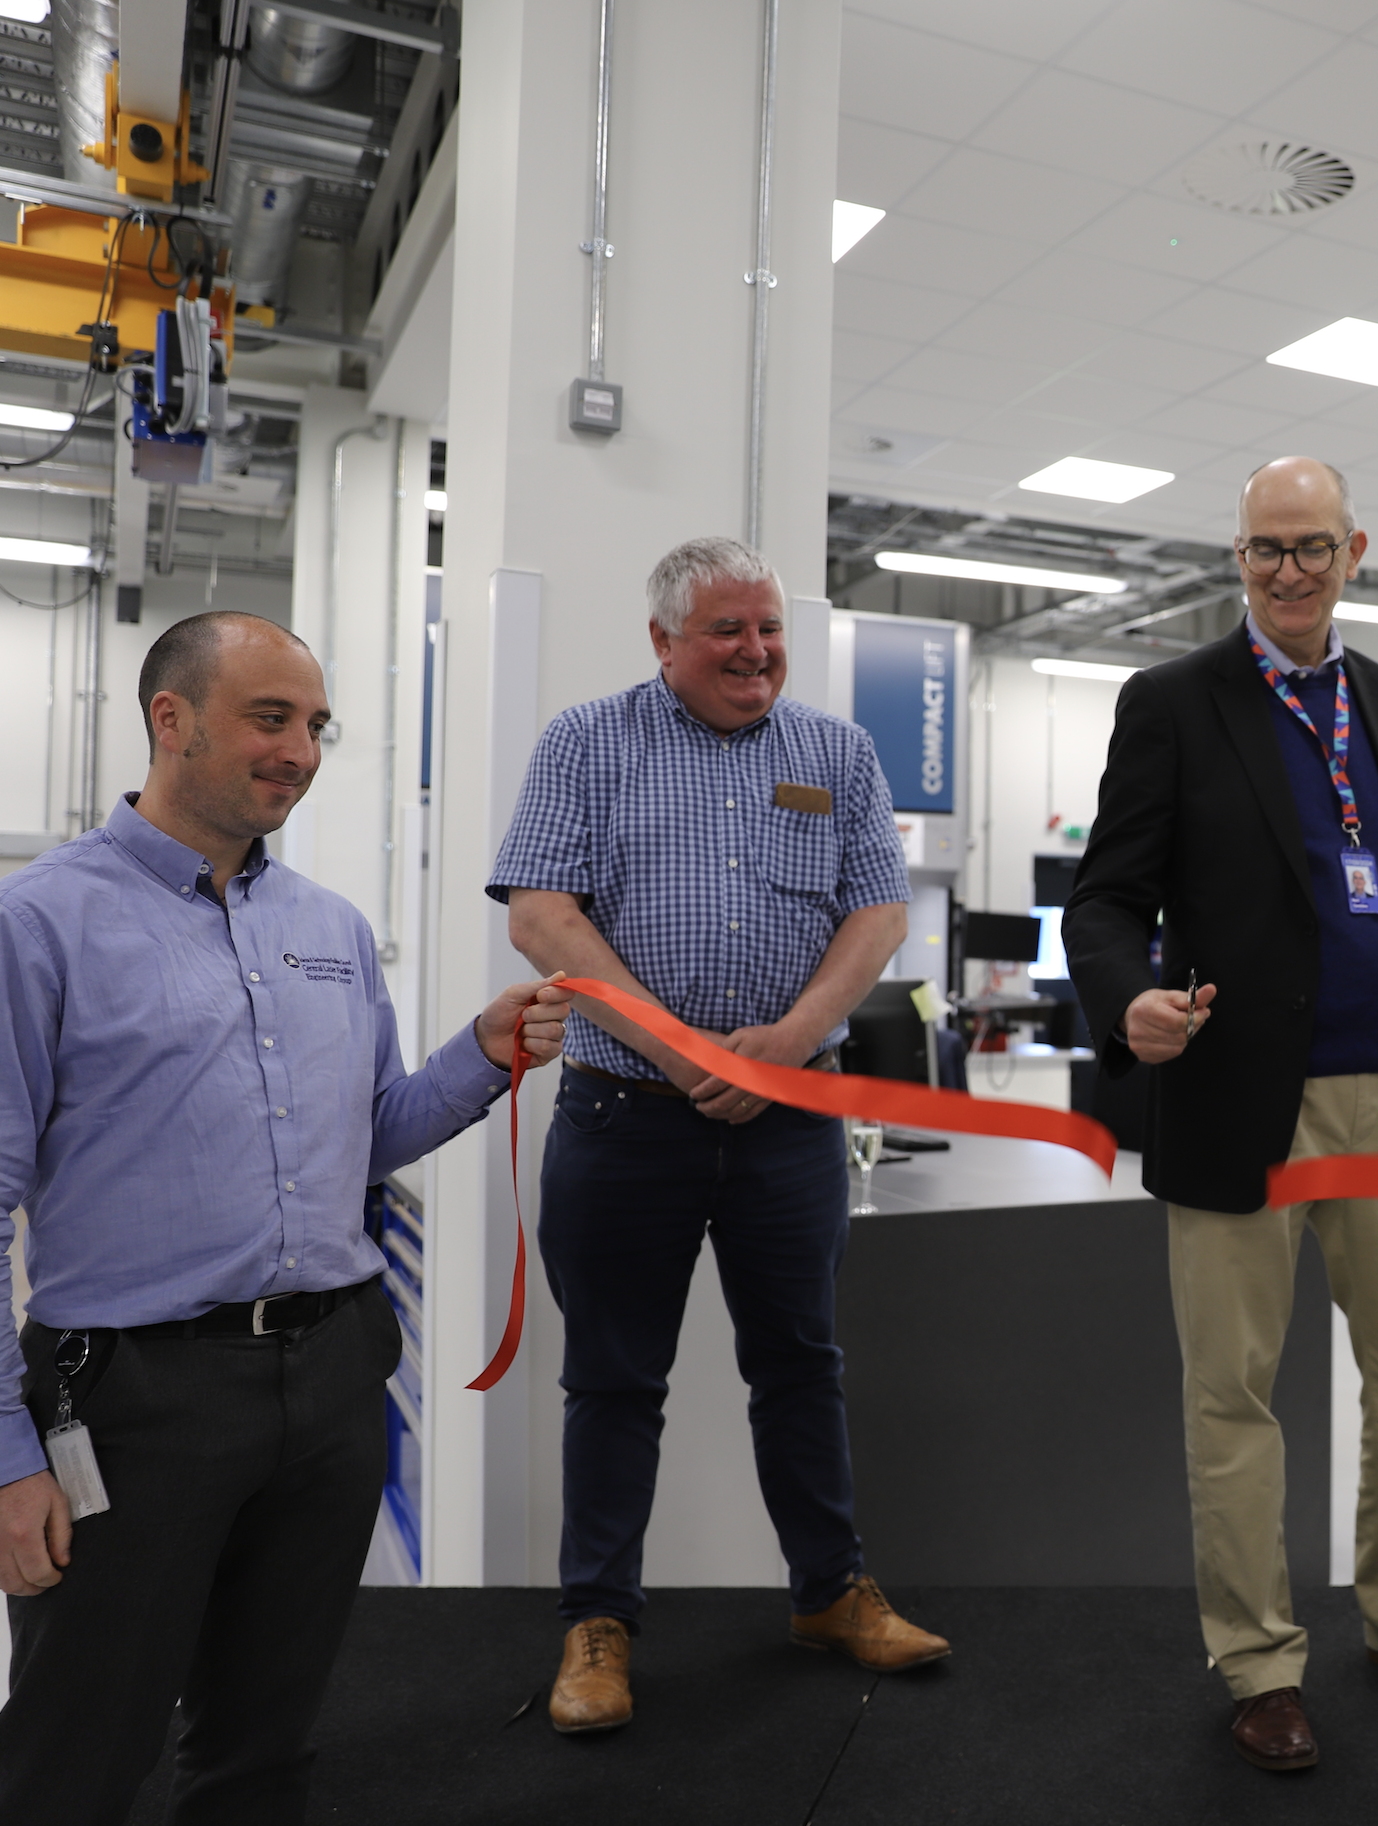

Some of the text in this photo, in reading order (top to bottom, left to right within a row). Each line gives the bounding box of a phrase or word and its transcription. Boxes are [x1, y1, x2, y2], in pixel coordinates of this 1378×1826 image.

[921, 638, 945, 796] COMPACT LIFT
[305, 973, 352, 984] Engineering Group
